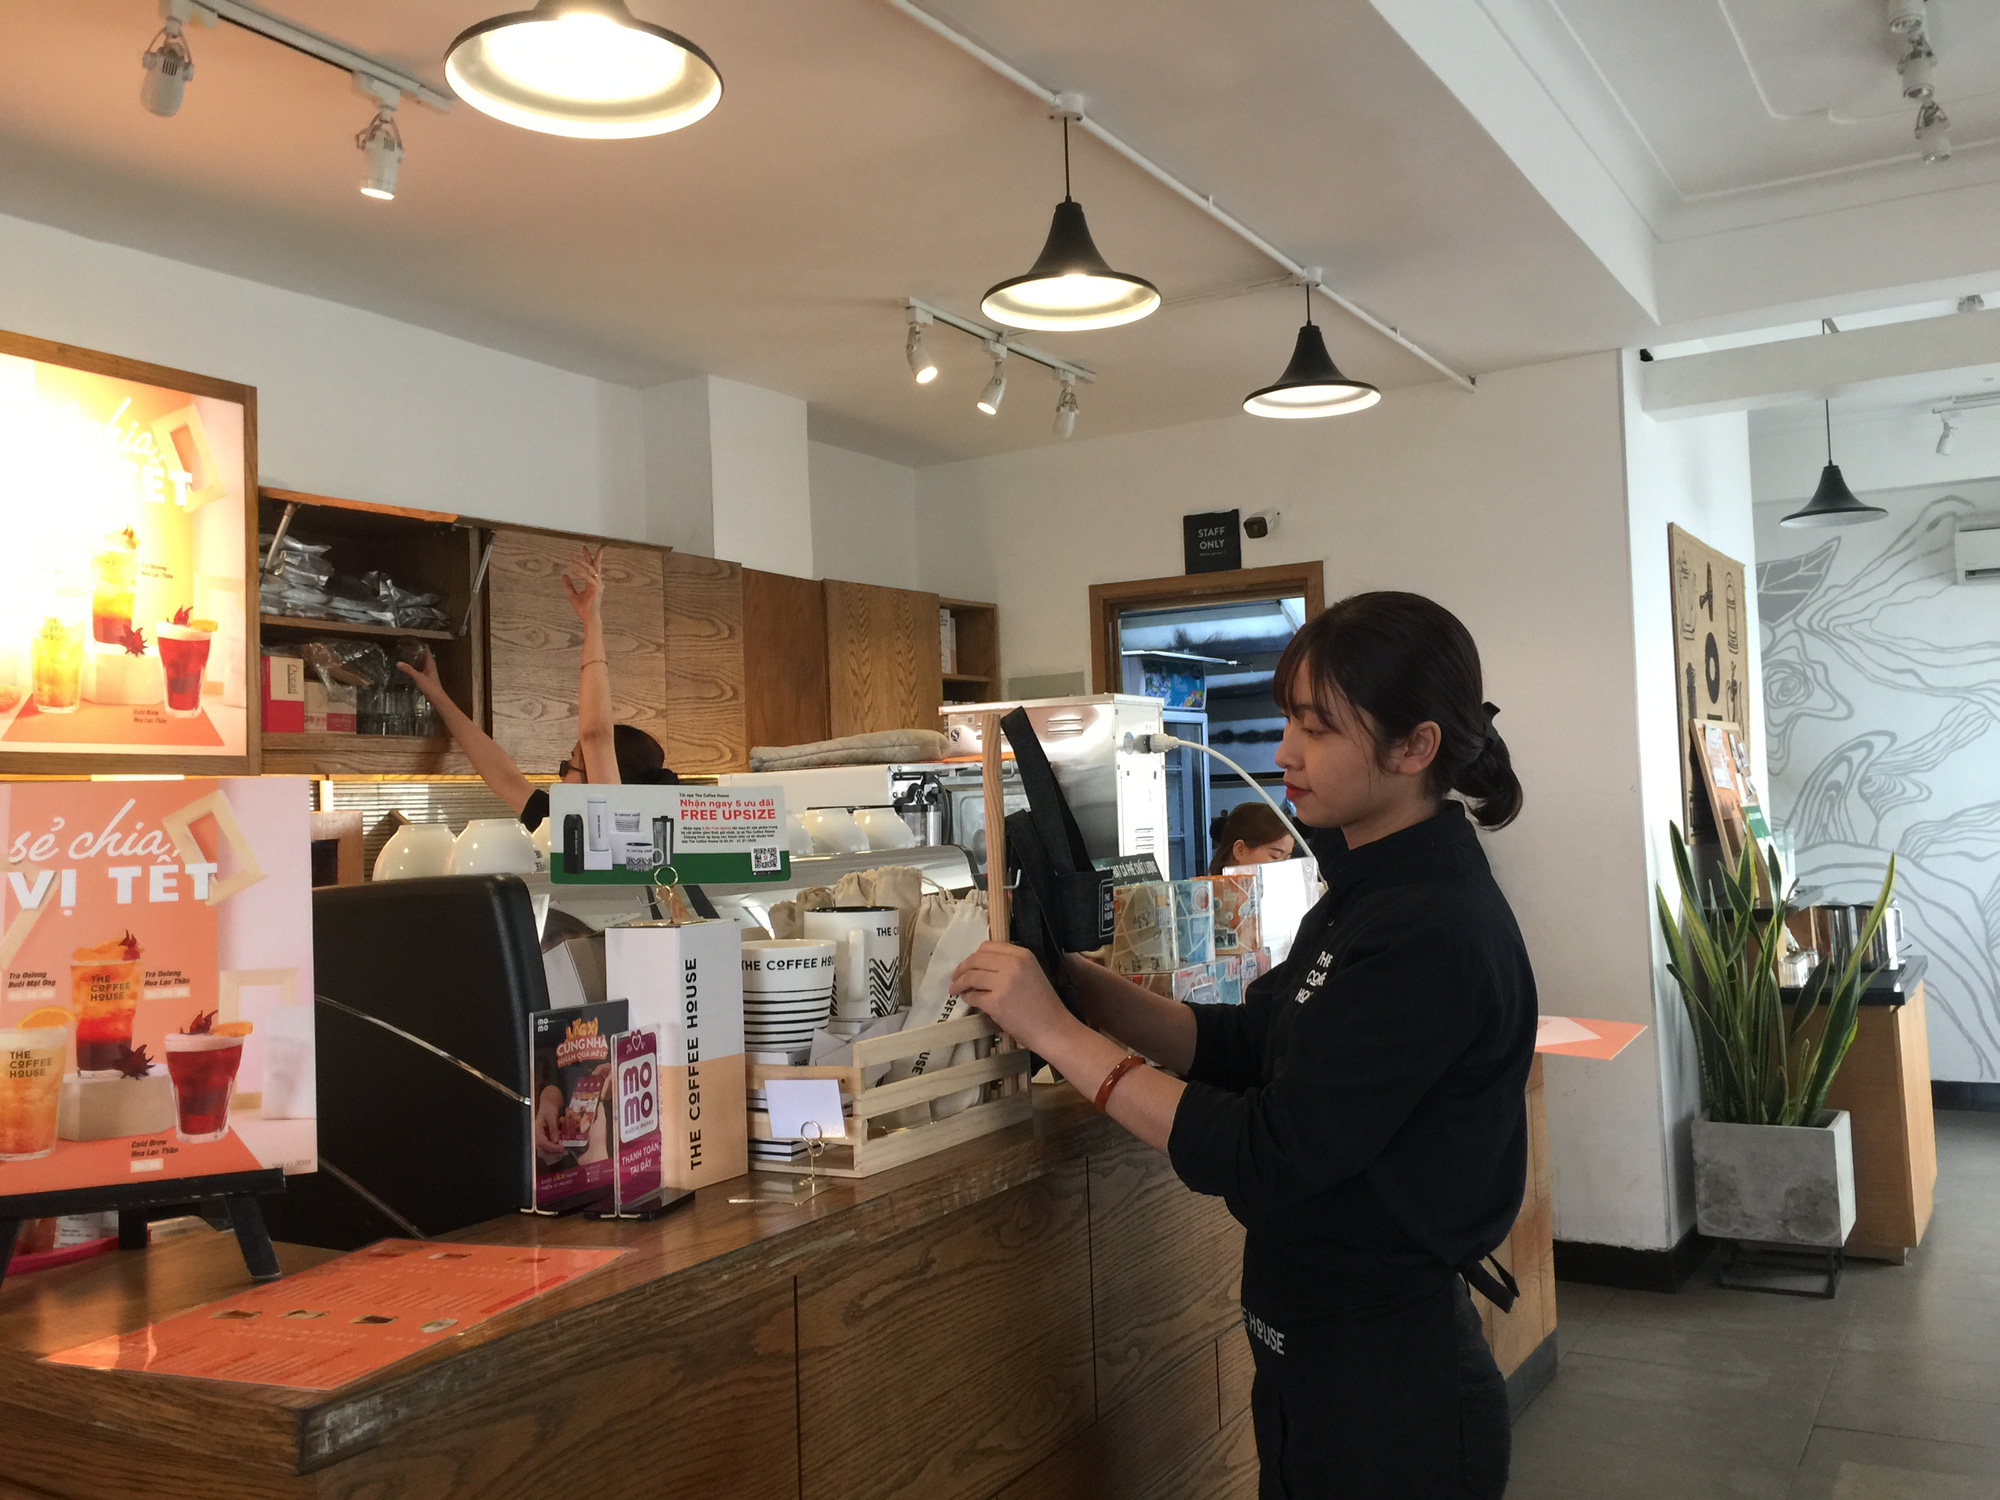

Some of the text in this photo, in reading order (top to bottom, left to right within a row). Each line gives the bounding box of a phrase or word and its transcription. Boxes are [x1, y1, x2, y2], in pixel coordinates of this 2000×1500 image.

[1198, 526, 1226, 537] STAFF
[1199, 539, 1225, 549] ONLY
[679, 799, 706, 809] Nhận
[708, 800, 732, 809] ngay
[758, 798, 774, 806] đãi
[680, 808, 776, 820] FREE UPSIZE
[8, 798, 171, 864] sẻ chia
[7, 849, 218, 916] VỊ TẾT
[876, 927, 892, 937] THE
[740, 960, 761, 971] THE
[766, 957, 818, 971] COFFEE
[91, 975, 111, 983] THE
[90, 982, 131, 993] COFFEE
[90, 992, 125, 1002] HOUSE
[9, 1051, 31, 1060] THE
[9, 1058, 53, 1069] COFFEE
[685, 958, 703, 1170] THE COFFEE HOUSE
[911, 1049, 931, 1076] USE
[9, 1068, 47, 1079] HOUSE
[623, 1061, 653, 1097] mo
[624, 1091, 654, 1127] mo
[621, 1141, 660, 1166] THANH TOÁN
[629, 1165, 640, 1178] TẠI
[1248, 1311, 1285, 1355] HOUSE
